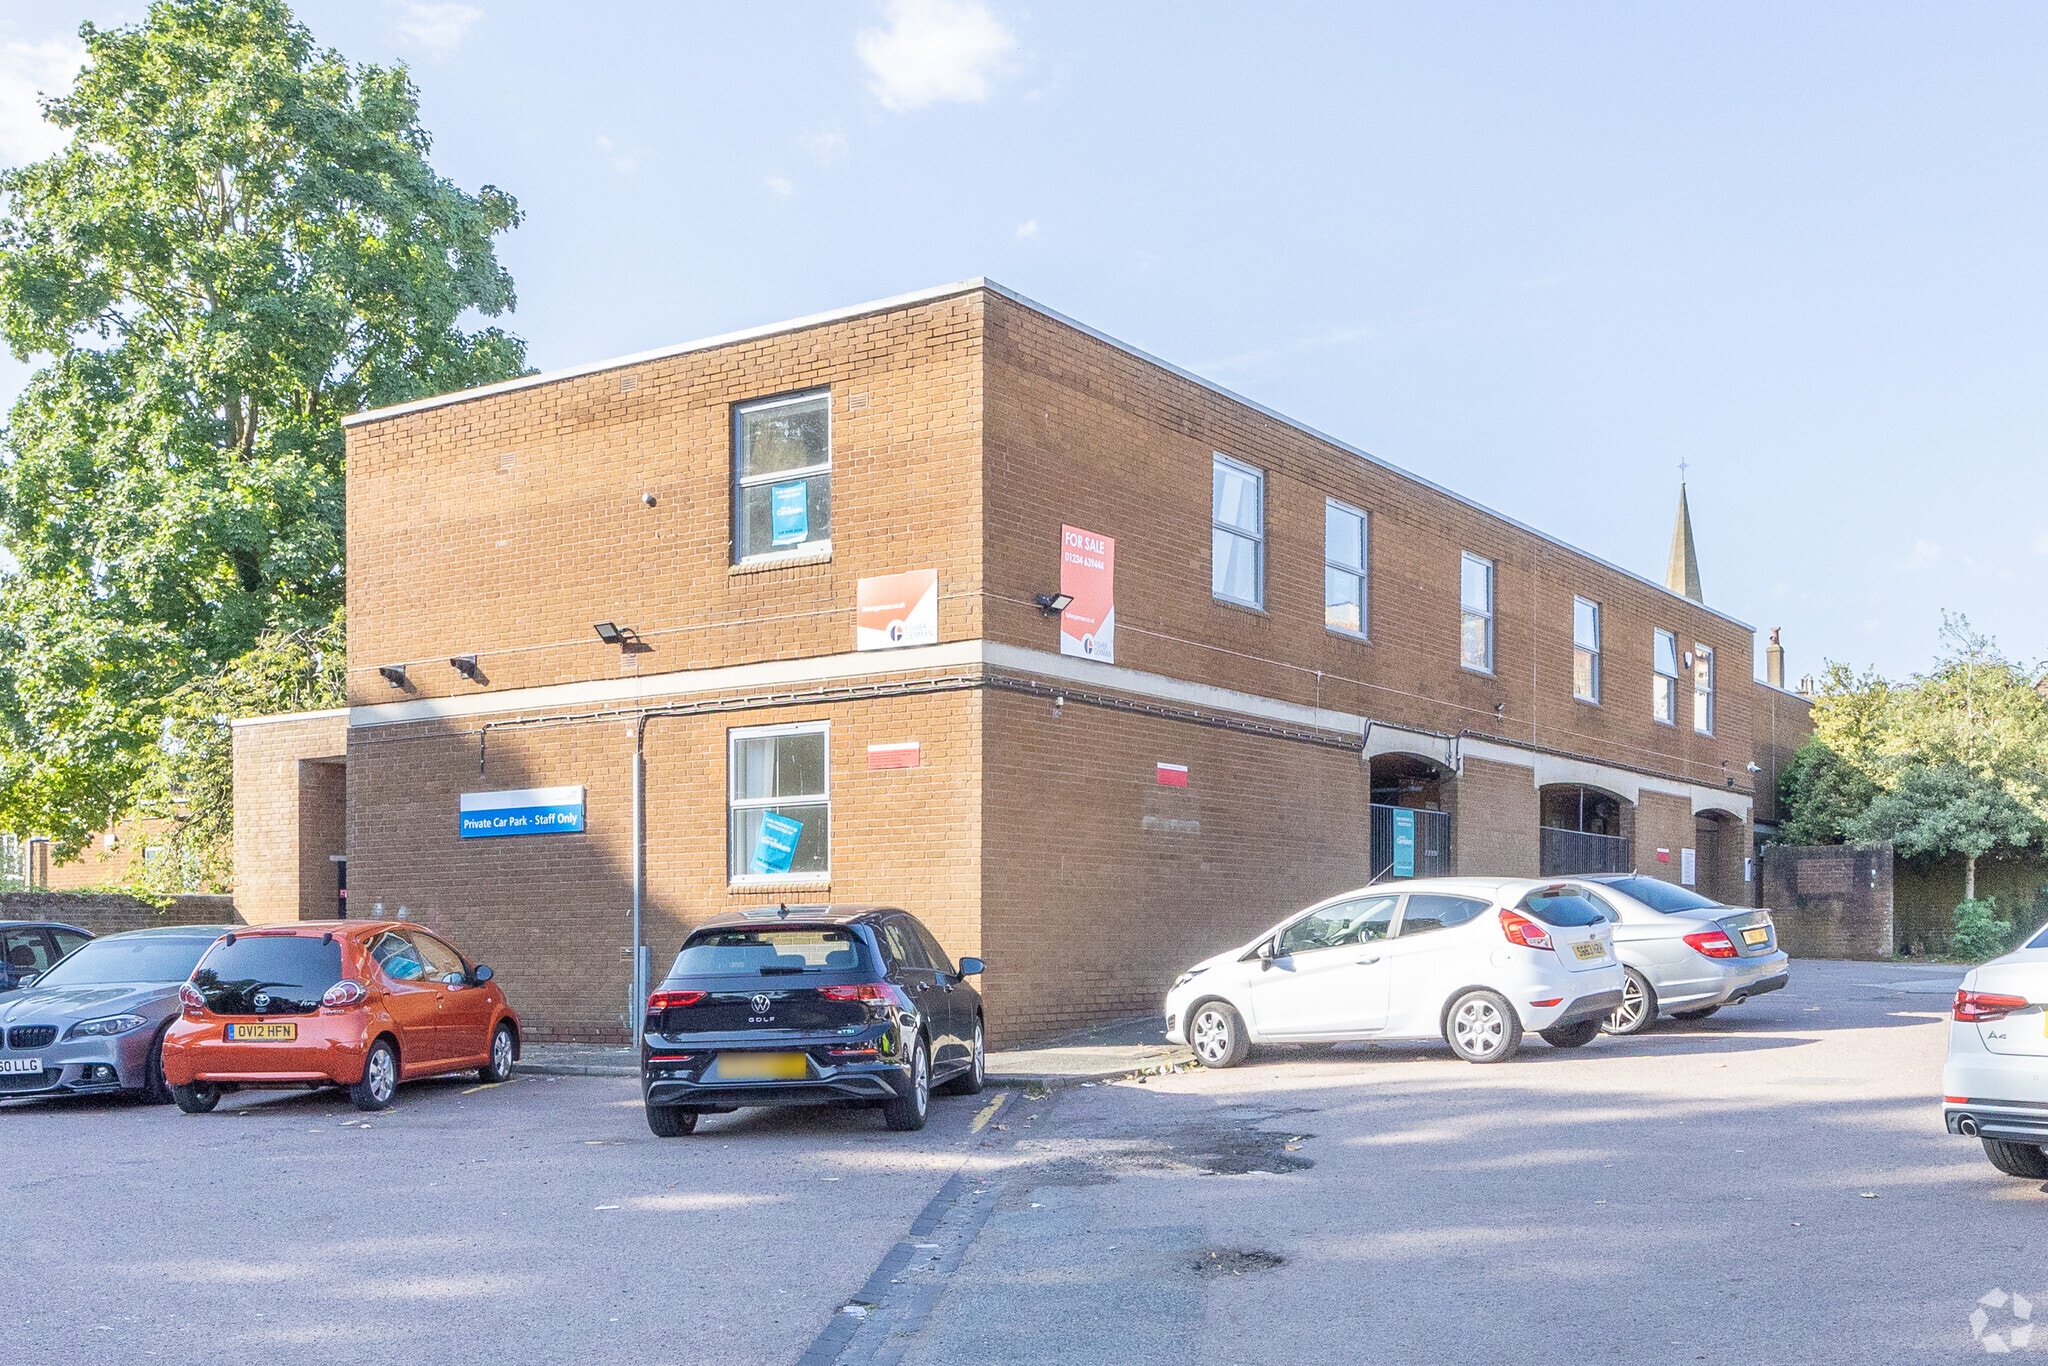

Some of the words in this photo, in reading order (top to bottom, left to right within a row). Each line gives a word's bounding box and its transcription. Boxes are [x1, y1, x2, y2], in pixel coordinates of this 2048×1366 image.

[1065, 531, 1083, 549] FOR
[1084, 537, 1105, 555] SALE
[1064, 552, 1083, 566] 01234
[1084, 556, 1105, 571] 639444
[463, 818, 492, 830] Private
[493, 817, 507, 828] Car
[509, 815, 528, 827] Park
[534, 813, 556, 825] Staff
[557, 812, 578, 826] Only
[238, 1025, 265, 1038] OV12
[267, 1025, 291, 1038] HFN
[1988, 1030, 2007, 1040] A4
[14, 1059, 38, 1072] LLG
